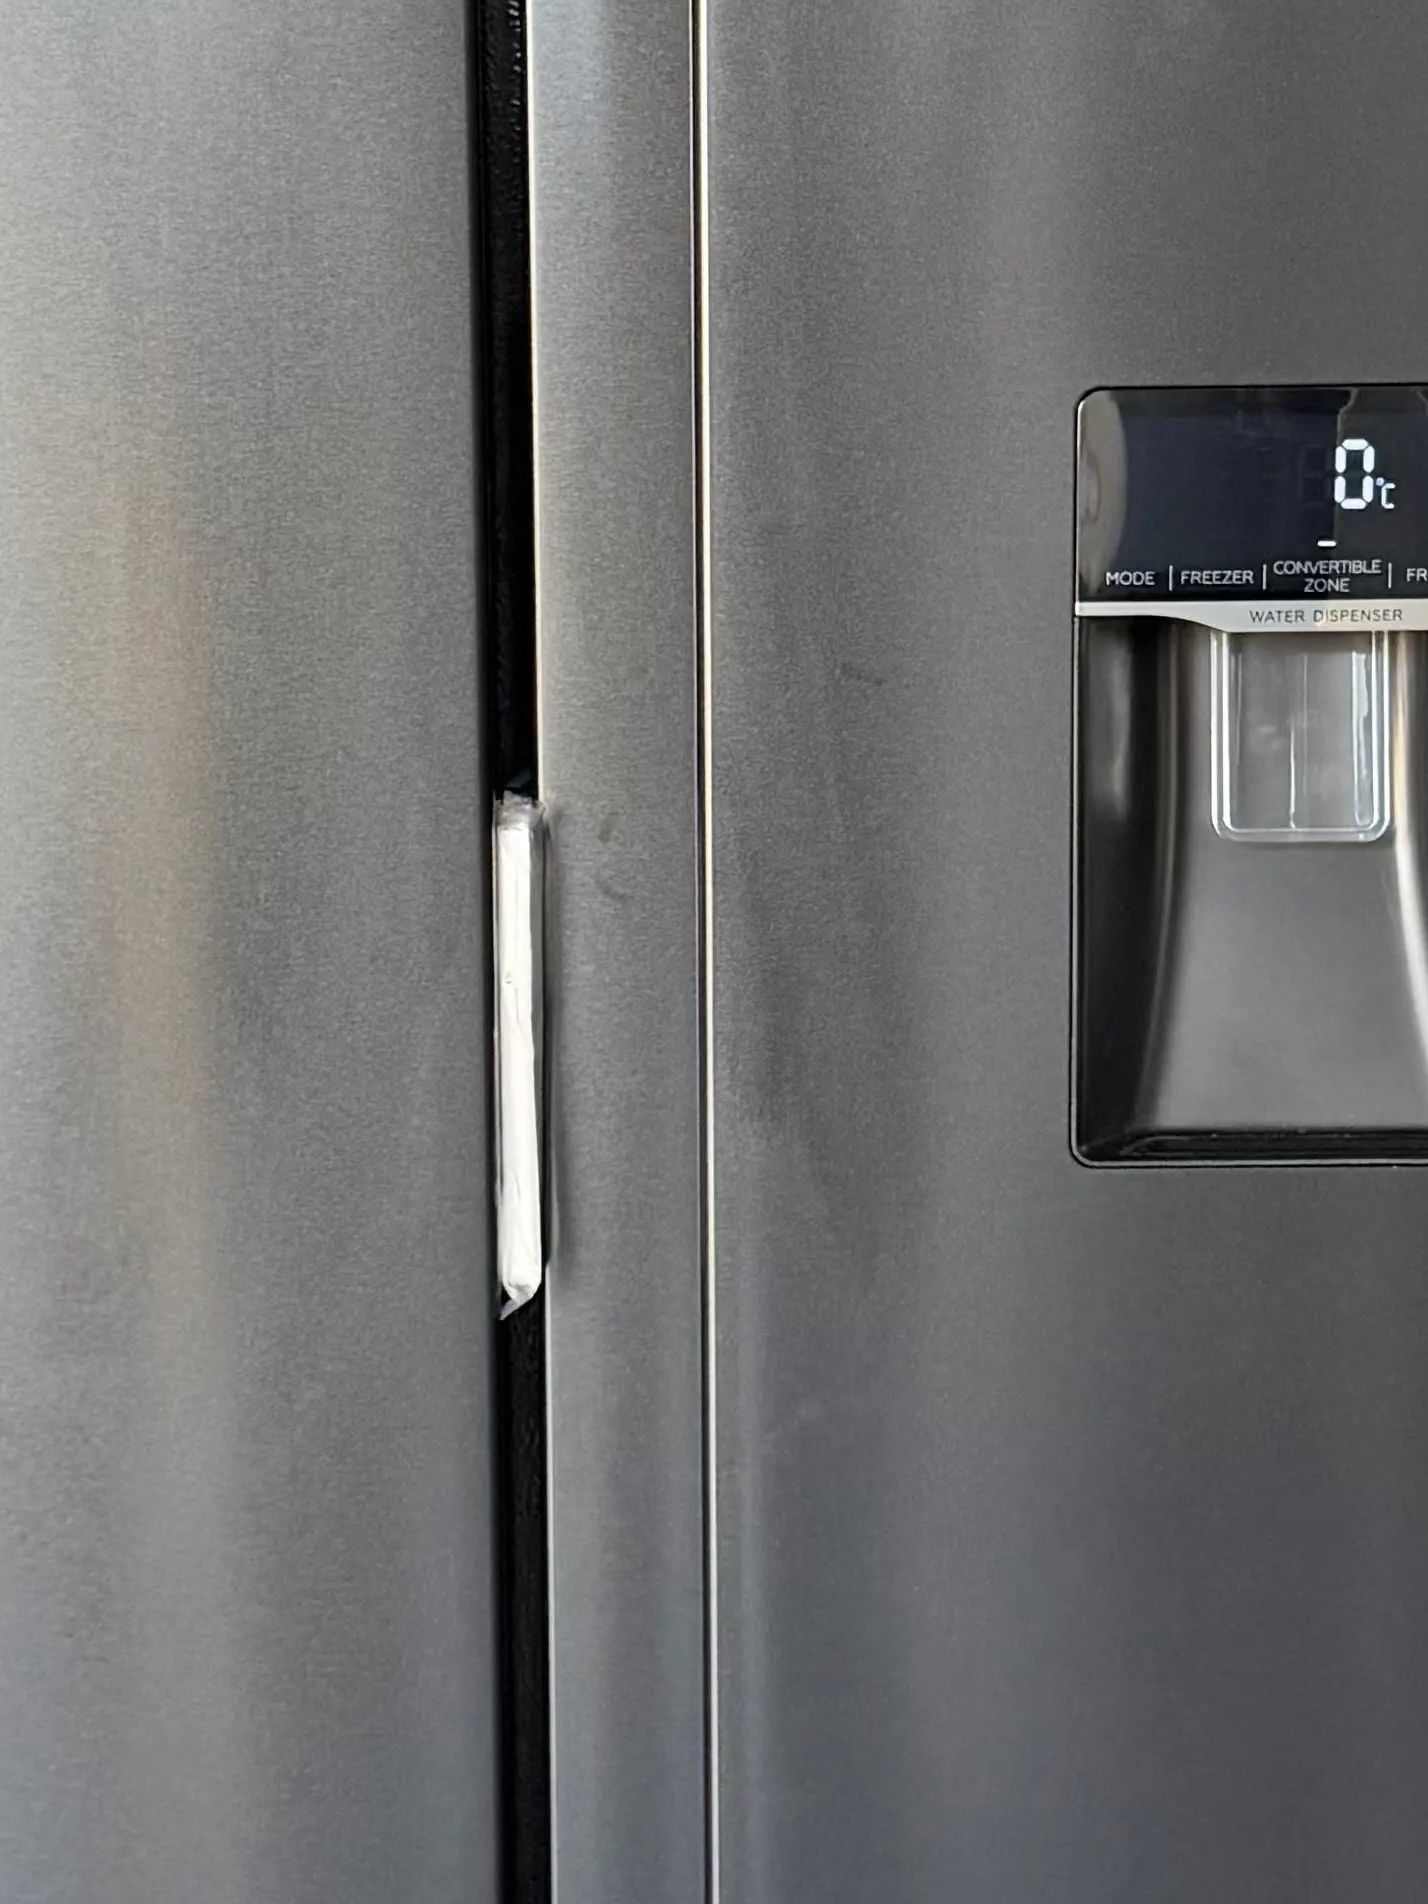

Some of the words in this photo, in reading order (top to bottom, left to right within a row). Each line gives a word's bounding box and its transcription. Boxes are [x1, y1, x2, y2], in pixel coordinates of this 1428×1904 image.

[1272, 559, 1383, 576] CONVERTIBLE
[1105, 570, 1156, 586] MODE
[1180, 569, 1255, 585] FREEZER
[1303, 577, 1351, 593] ZONE
[1249, 609, 1305, 624] WATER
[1312, 608, 1403, 624] DISPENSER
